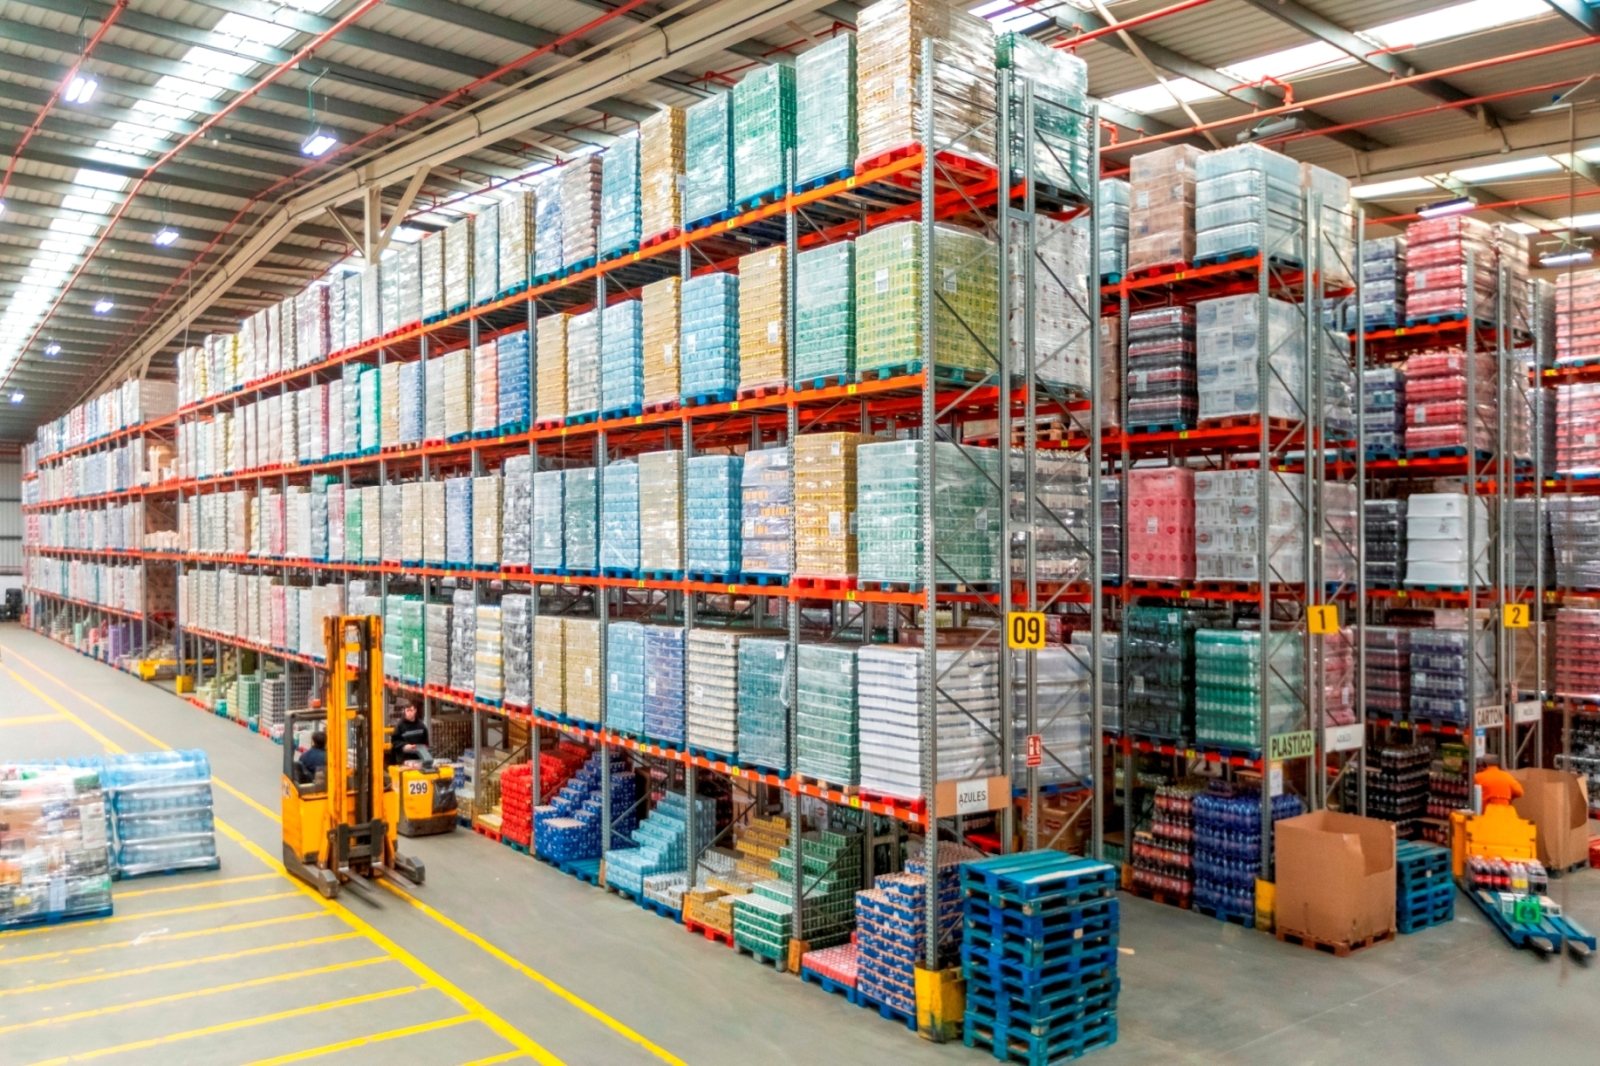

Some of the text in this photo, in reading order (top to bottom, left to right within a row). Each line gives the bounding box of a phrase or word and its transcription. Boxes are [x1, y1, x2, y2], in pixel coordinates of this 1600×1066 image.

[1318, 608, 1326, 630] 1
[1512, 606, 1521, 624] 2
[1014, 616, 1040, 645] 09
[1271, 732, 1312, 758] PLASTICO
[410, 782, 428, 795] 299
[959, 790, 987, 804] AZULES
